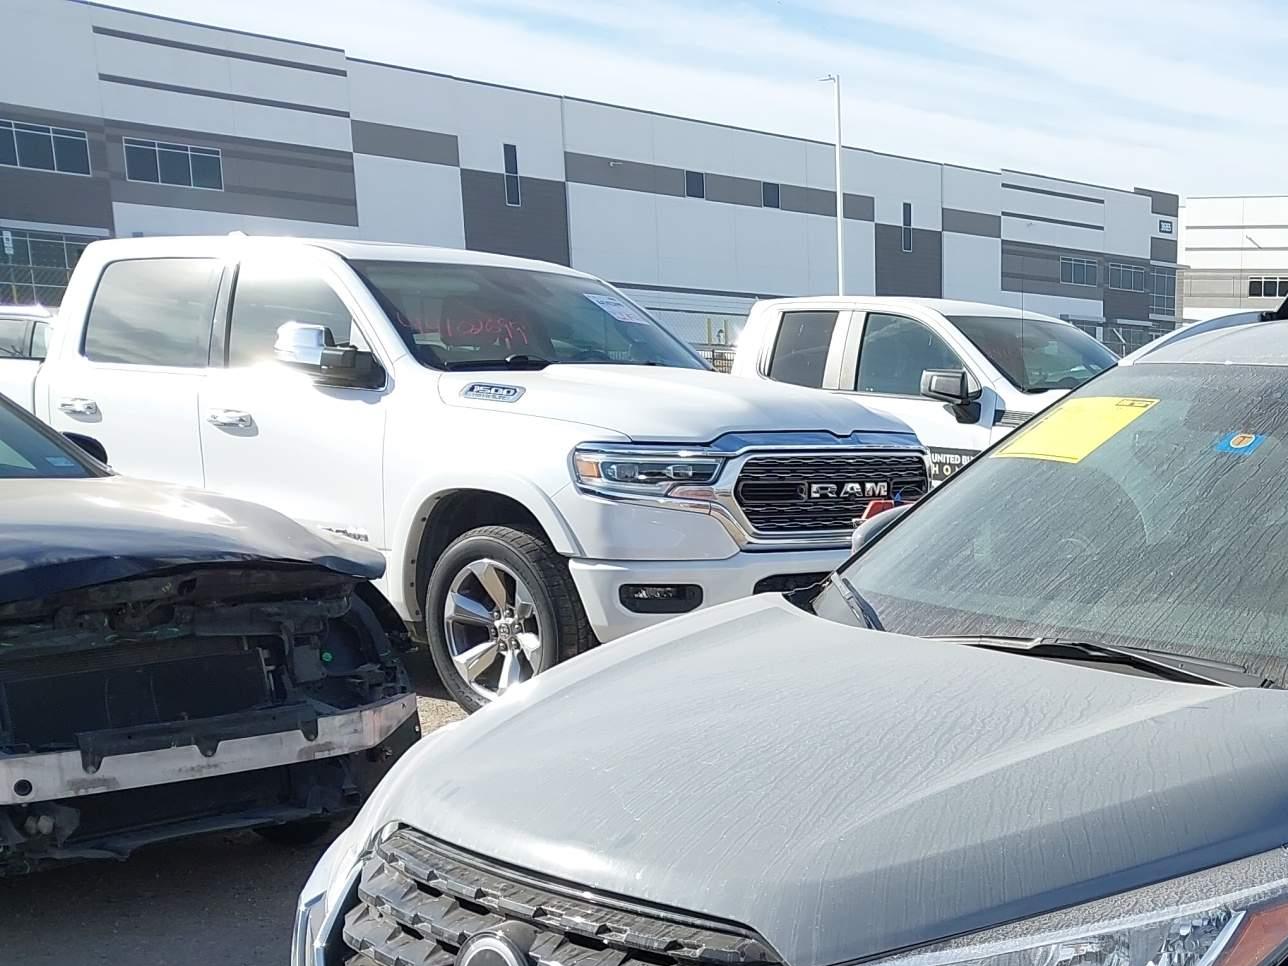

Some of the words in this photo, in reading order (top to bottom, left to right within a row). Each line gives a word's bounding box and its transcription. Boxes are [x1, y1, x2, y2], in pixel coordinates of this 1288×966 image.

[473, 385, 514, 396] 1500
[931, 453, 961, 465] UNITED
[810, 482, 889, 498] RAM
